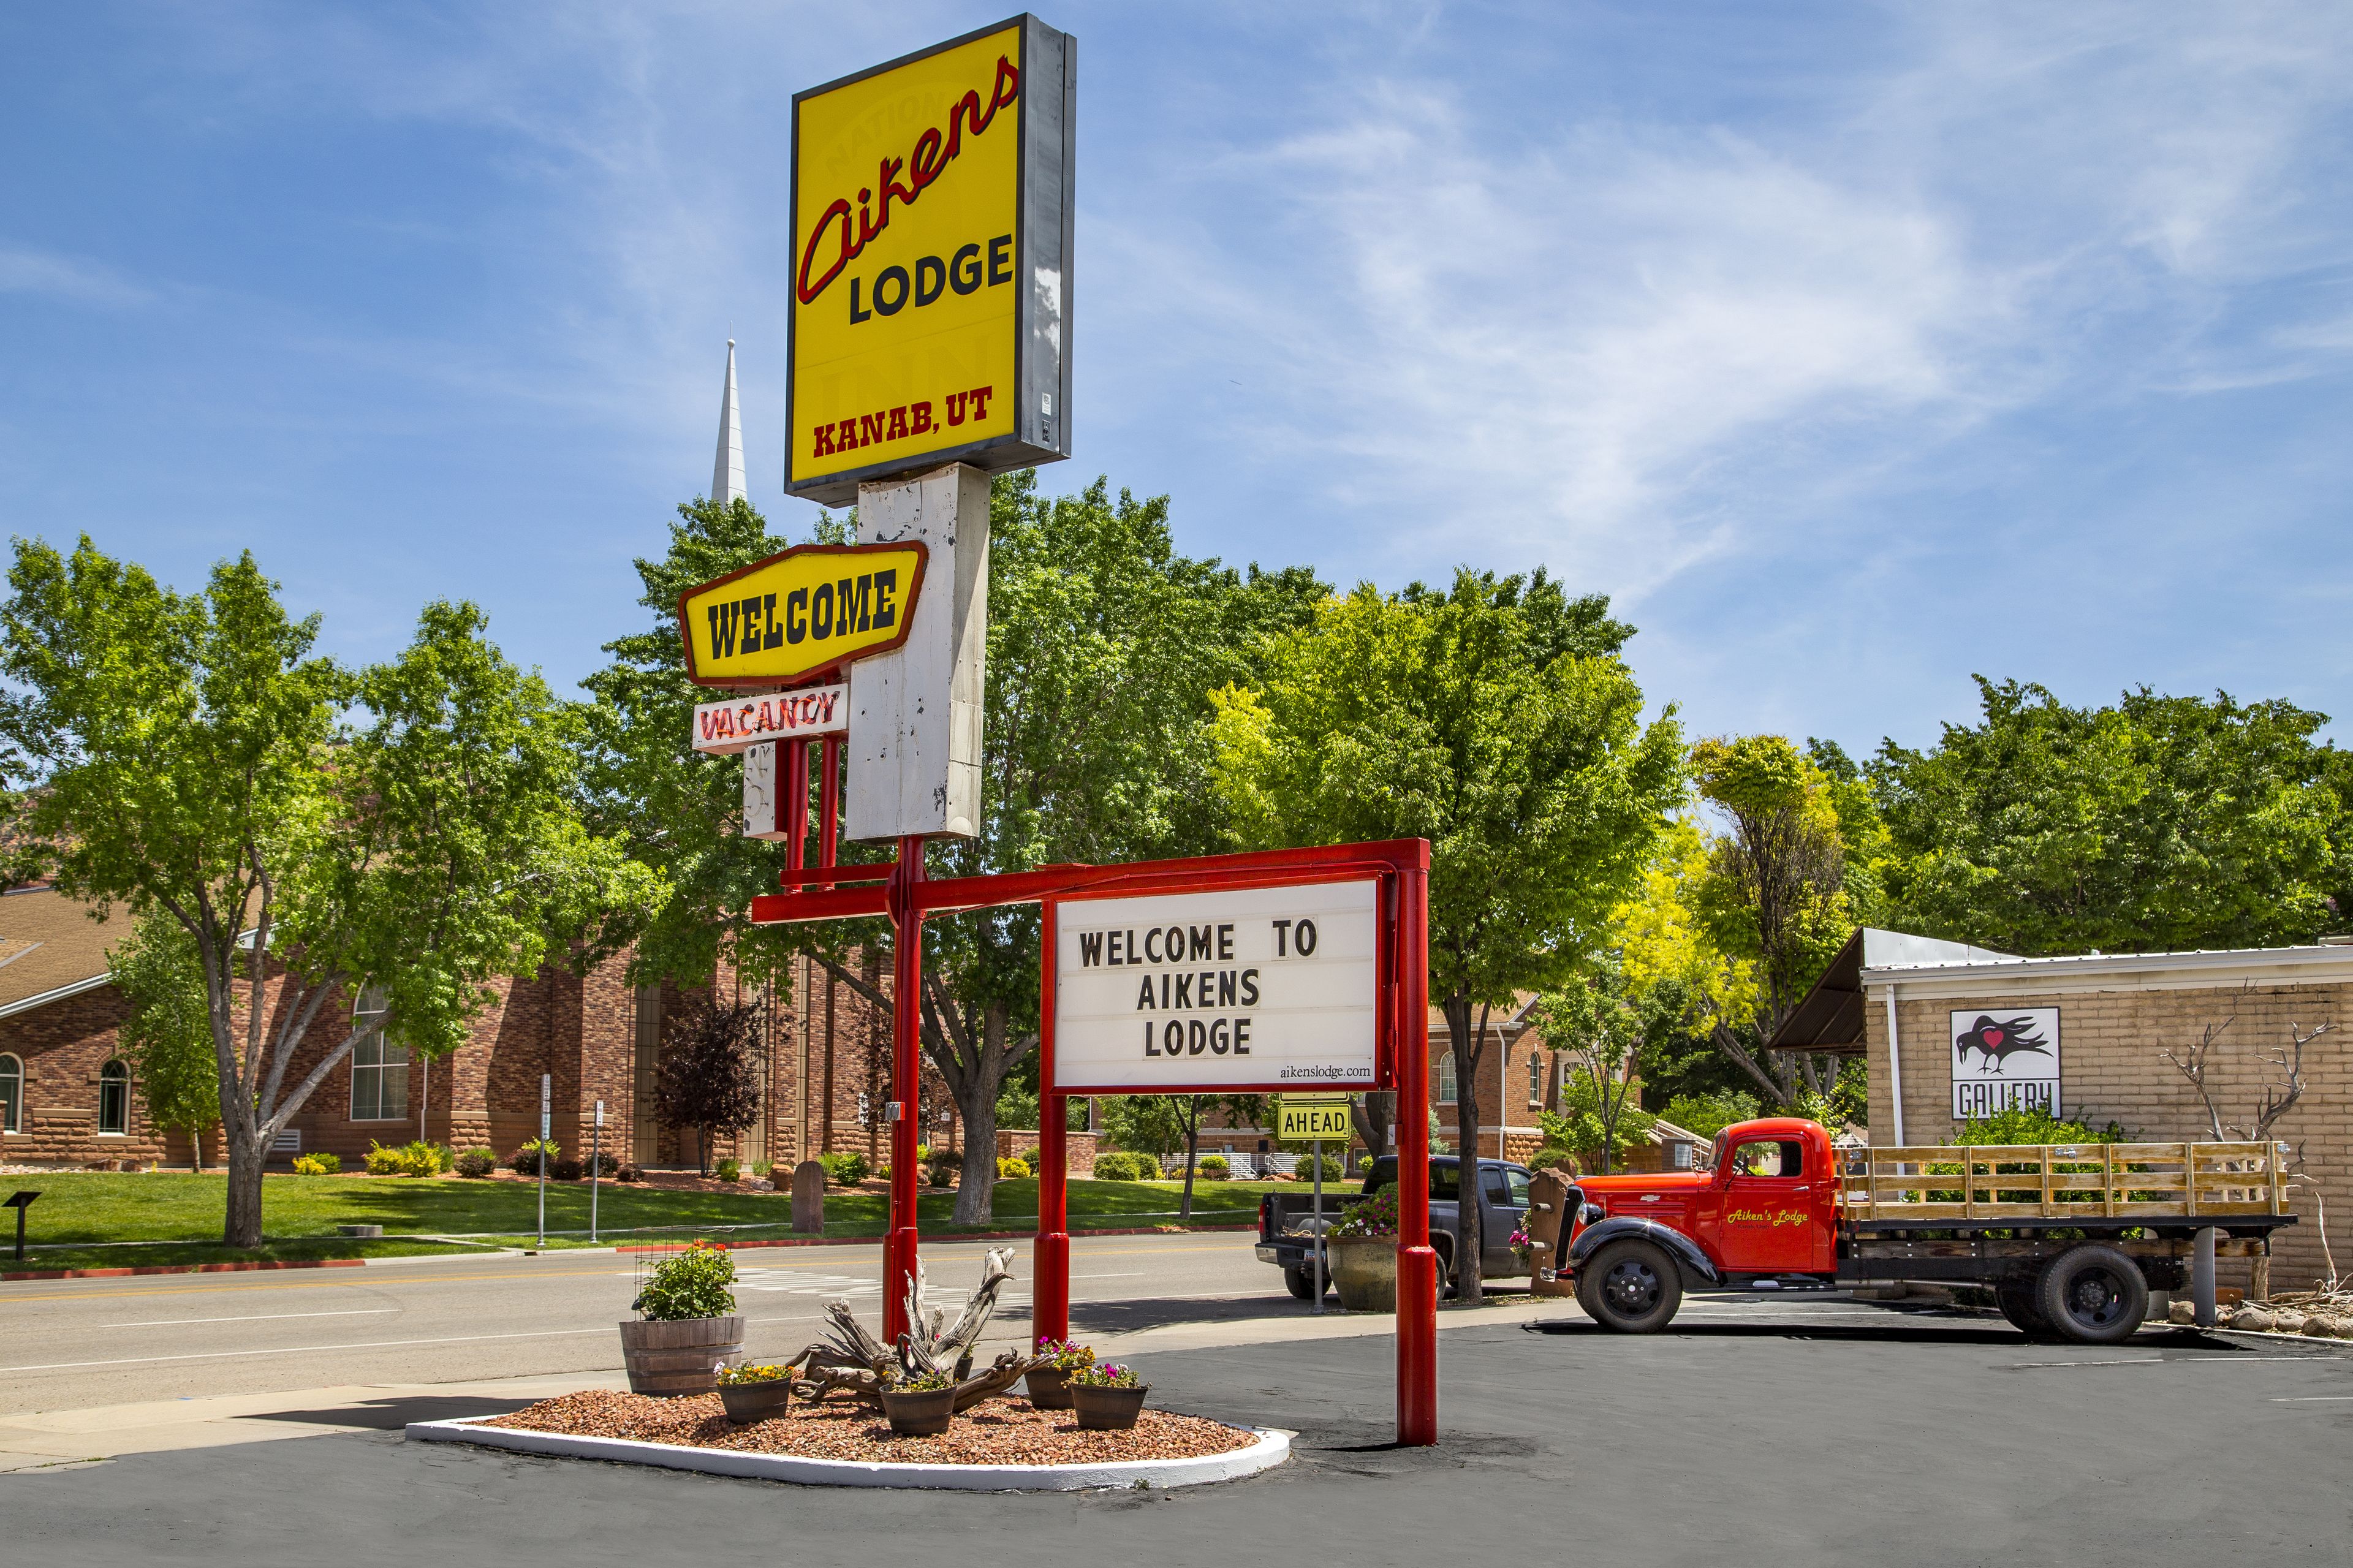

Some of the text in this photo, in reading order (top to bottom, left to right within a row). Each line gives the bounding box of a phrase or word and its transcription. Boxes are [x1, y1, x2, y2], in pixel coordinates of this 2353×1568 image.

[798, 54, 1018, 305] Aikens
[849, 233, 1013, 325] LODGE
[814, 385, 993, 458] KANAB, UT
[708, 568, 896, 660] WELCOME
[699, 690, 841, 740] VACANCY
[1080, 919, 1317, 967] WELCOME TO
[1137, 969, 1259, 1010] AIKENS
[1145, 1018, 1251, 1057] LODGE
[1280, 1065, 1371, 1079] aikenslodge.com
[1959, 1082, 2052, 1115] GALLERY
[1284, 1112, 1345, 1132] AHEAD
[1727, 1209, 1809, 1228] Aiken's Lodge
